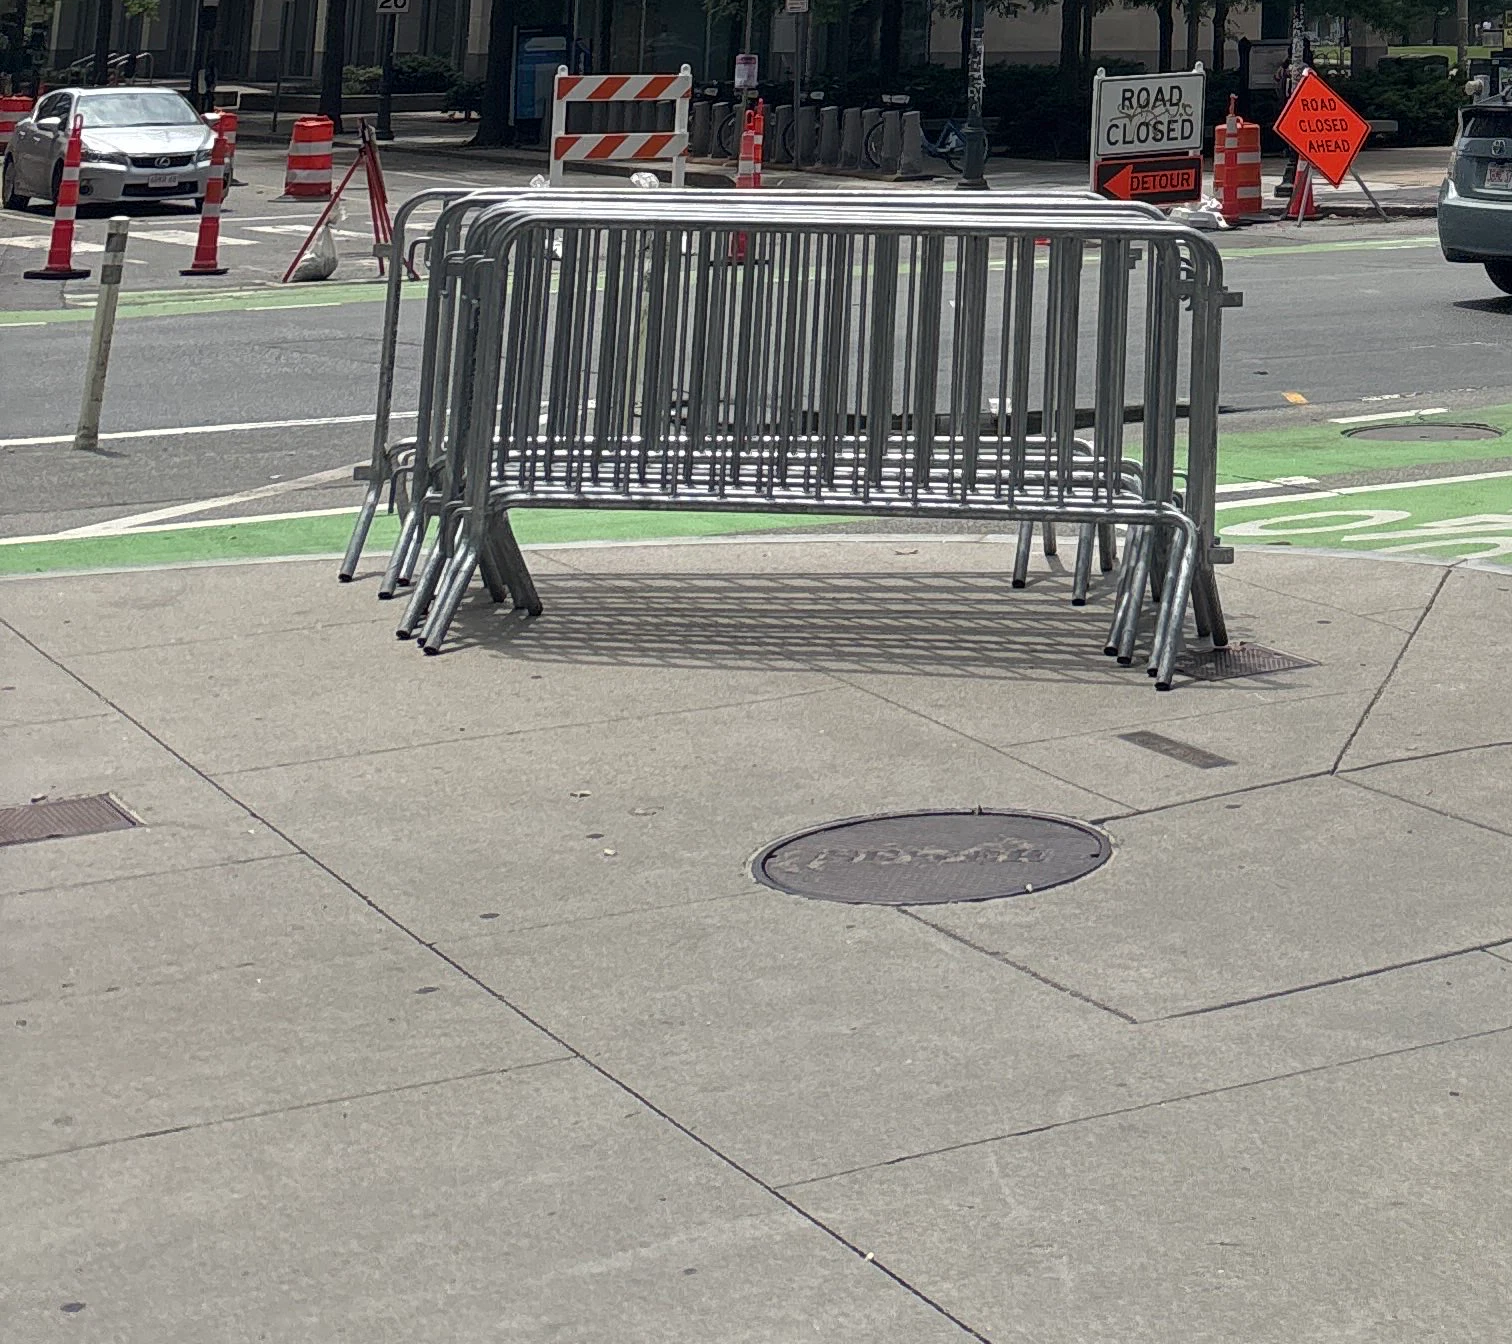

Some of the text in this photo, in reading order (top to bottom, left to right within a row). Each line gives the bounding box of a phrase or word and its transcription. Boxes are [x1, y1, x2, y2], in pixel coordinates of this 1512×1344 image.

[1121, 85, 1183, 110] ROAD
[1301, 98, 1337, 111] ROAD
[1106, 118, 1194, 146] CLOSED
[1299, 118, 1348, 132] CLOSED
[1308, 140, 1350, 153] AHEAD
[1130, 173, 1191, 191] DETOUR
